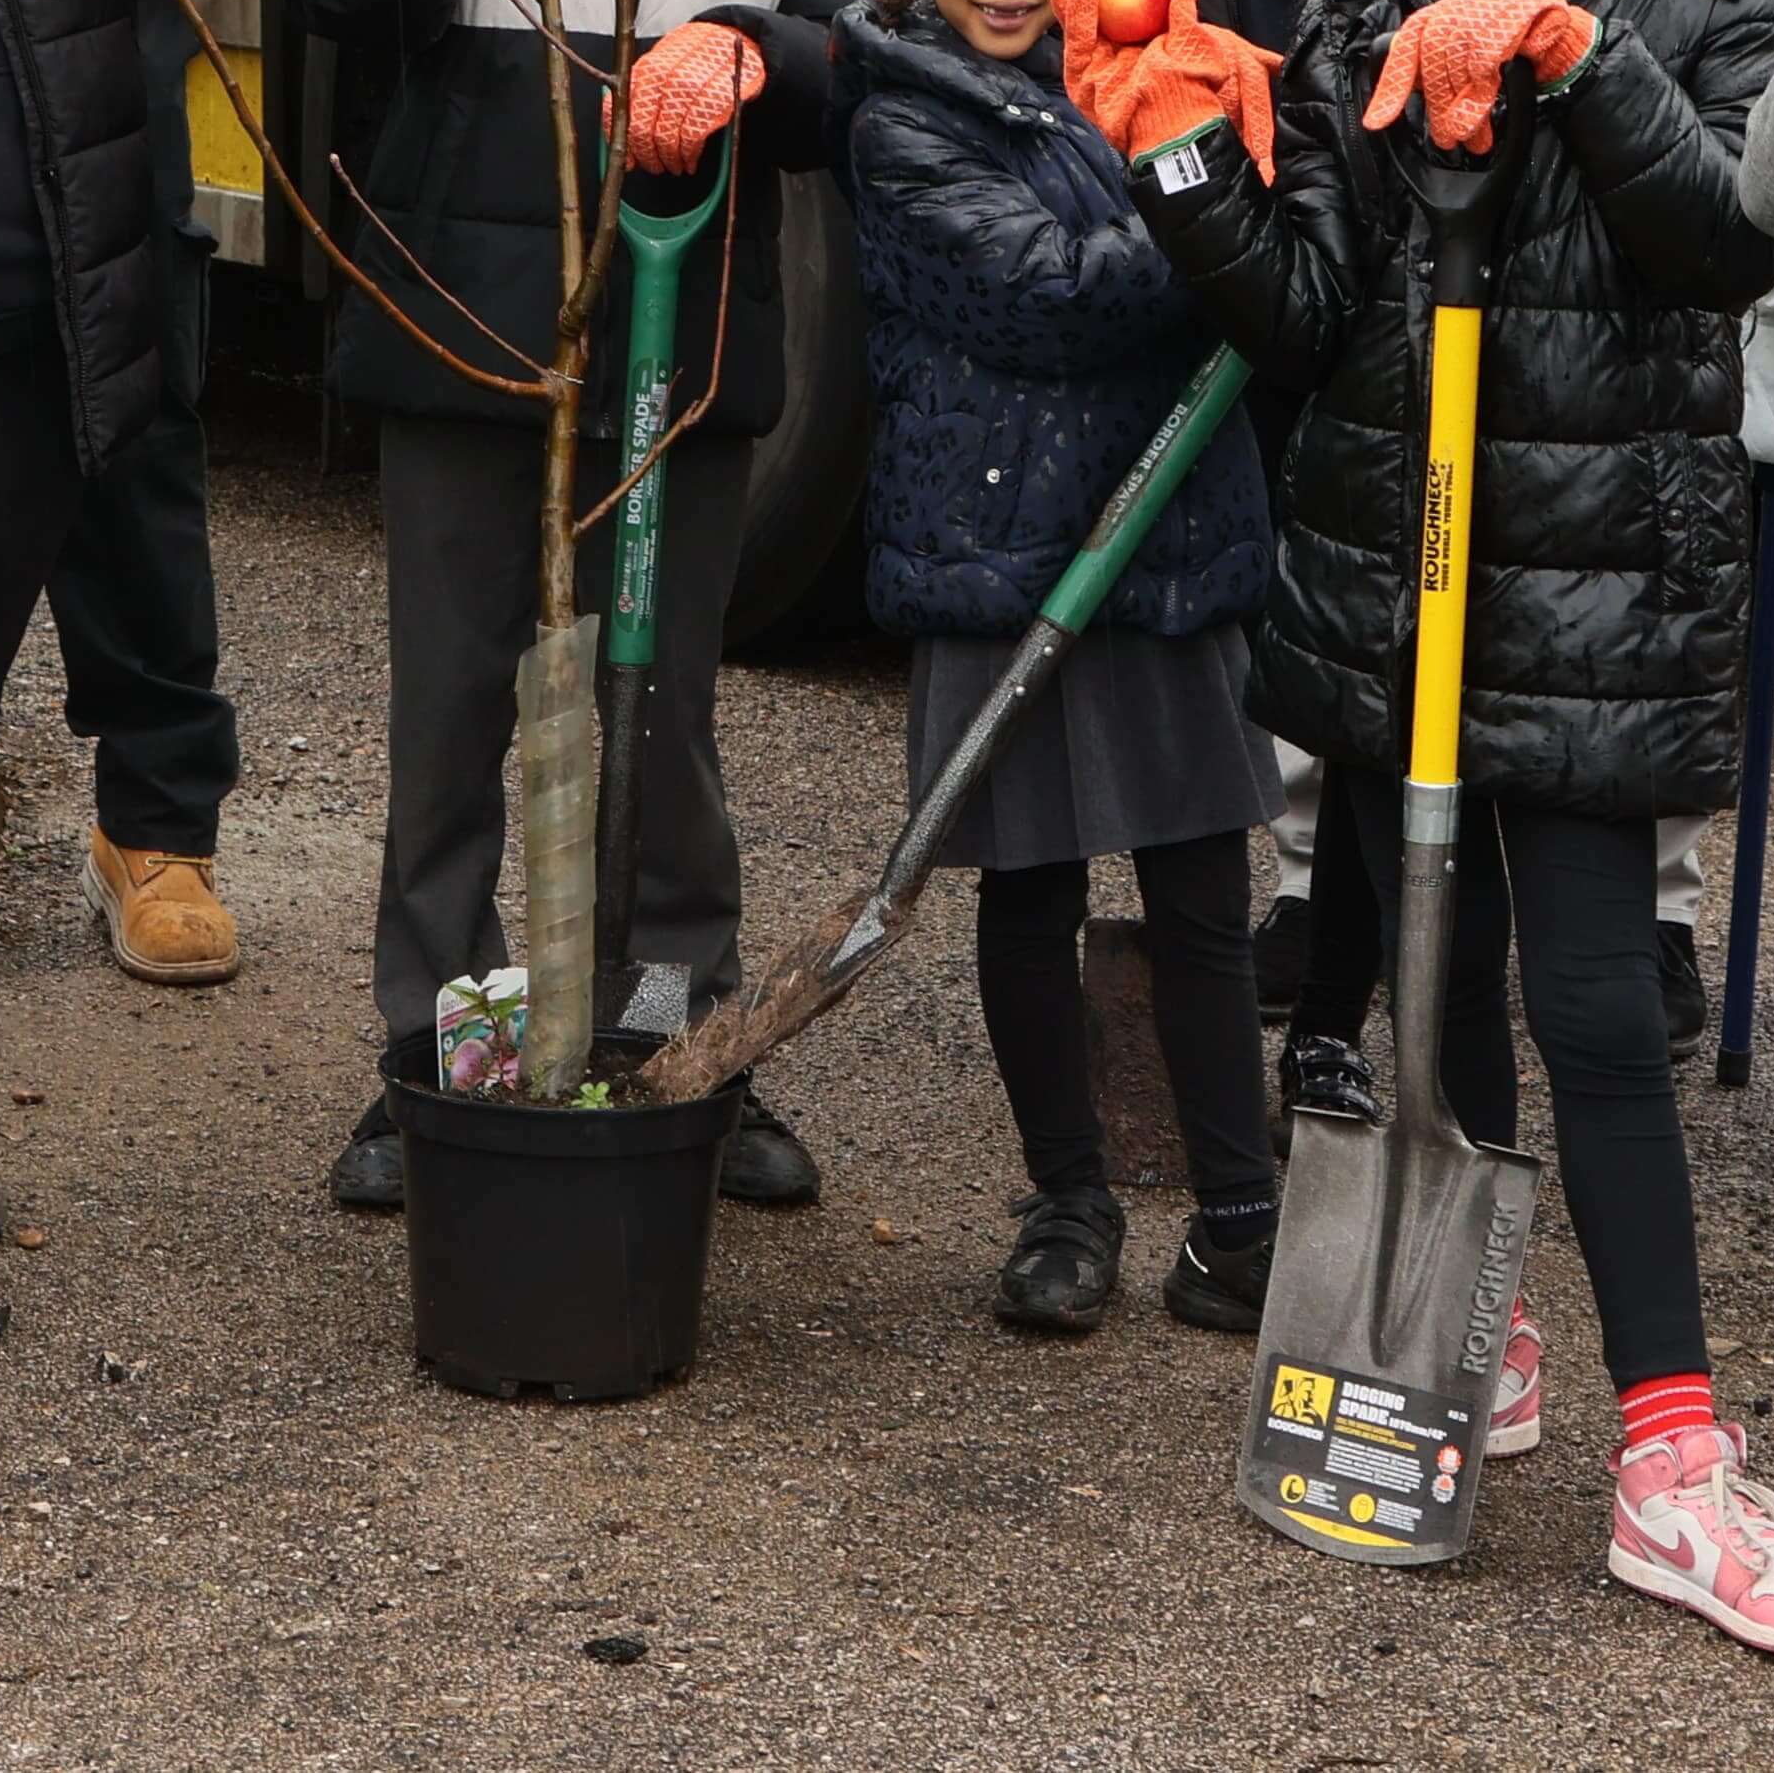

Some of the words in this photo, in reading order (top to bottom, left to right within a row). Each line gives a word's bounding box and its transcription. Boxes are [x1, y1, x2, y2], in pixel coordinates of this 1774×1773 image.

[632, 392, 651, 448] SPADE
[1138, 402, 1189, 470] BORDER
[1424, 458, 1443, 593] ROUGHNECK
[1461, 1199, 1519, 1375] ROUGHNECK
[1337, 1398, 1390, 1426] SPADE
[1340, 1380, 1407, 1412] DIGGING
